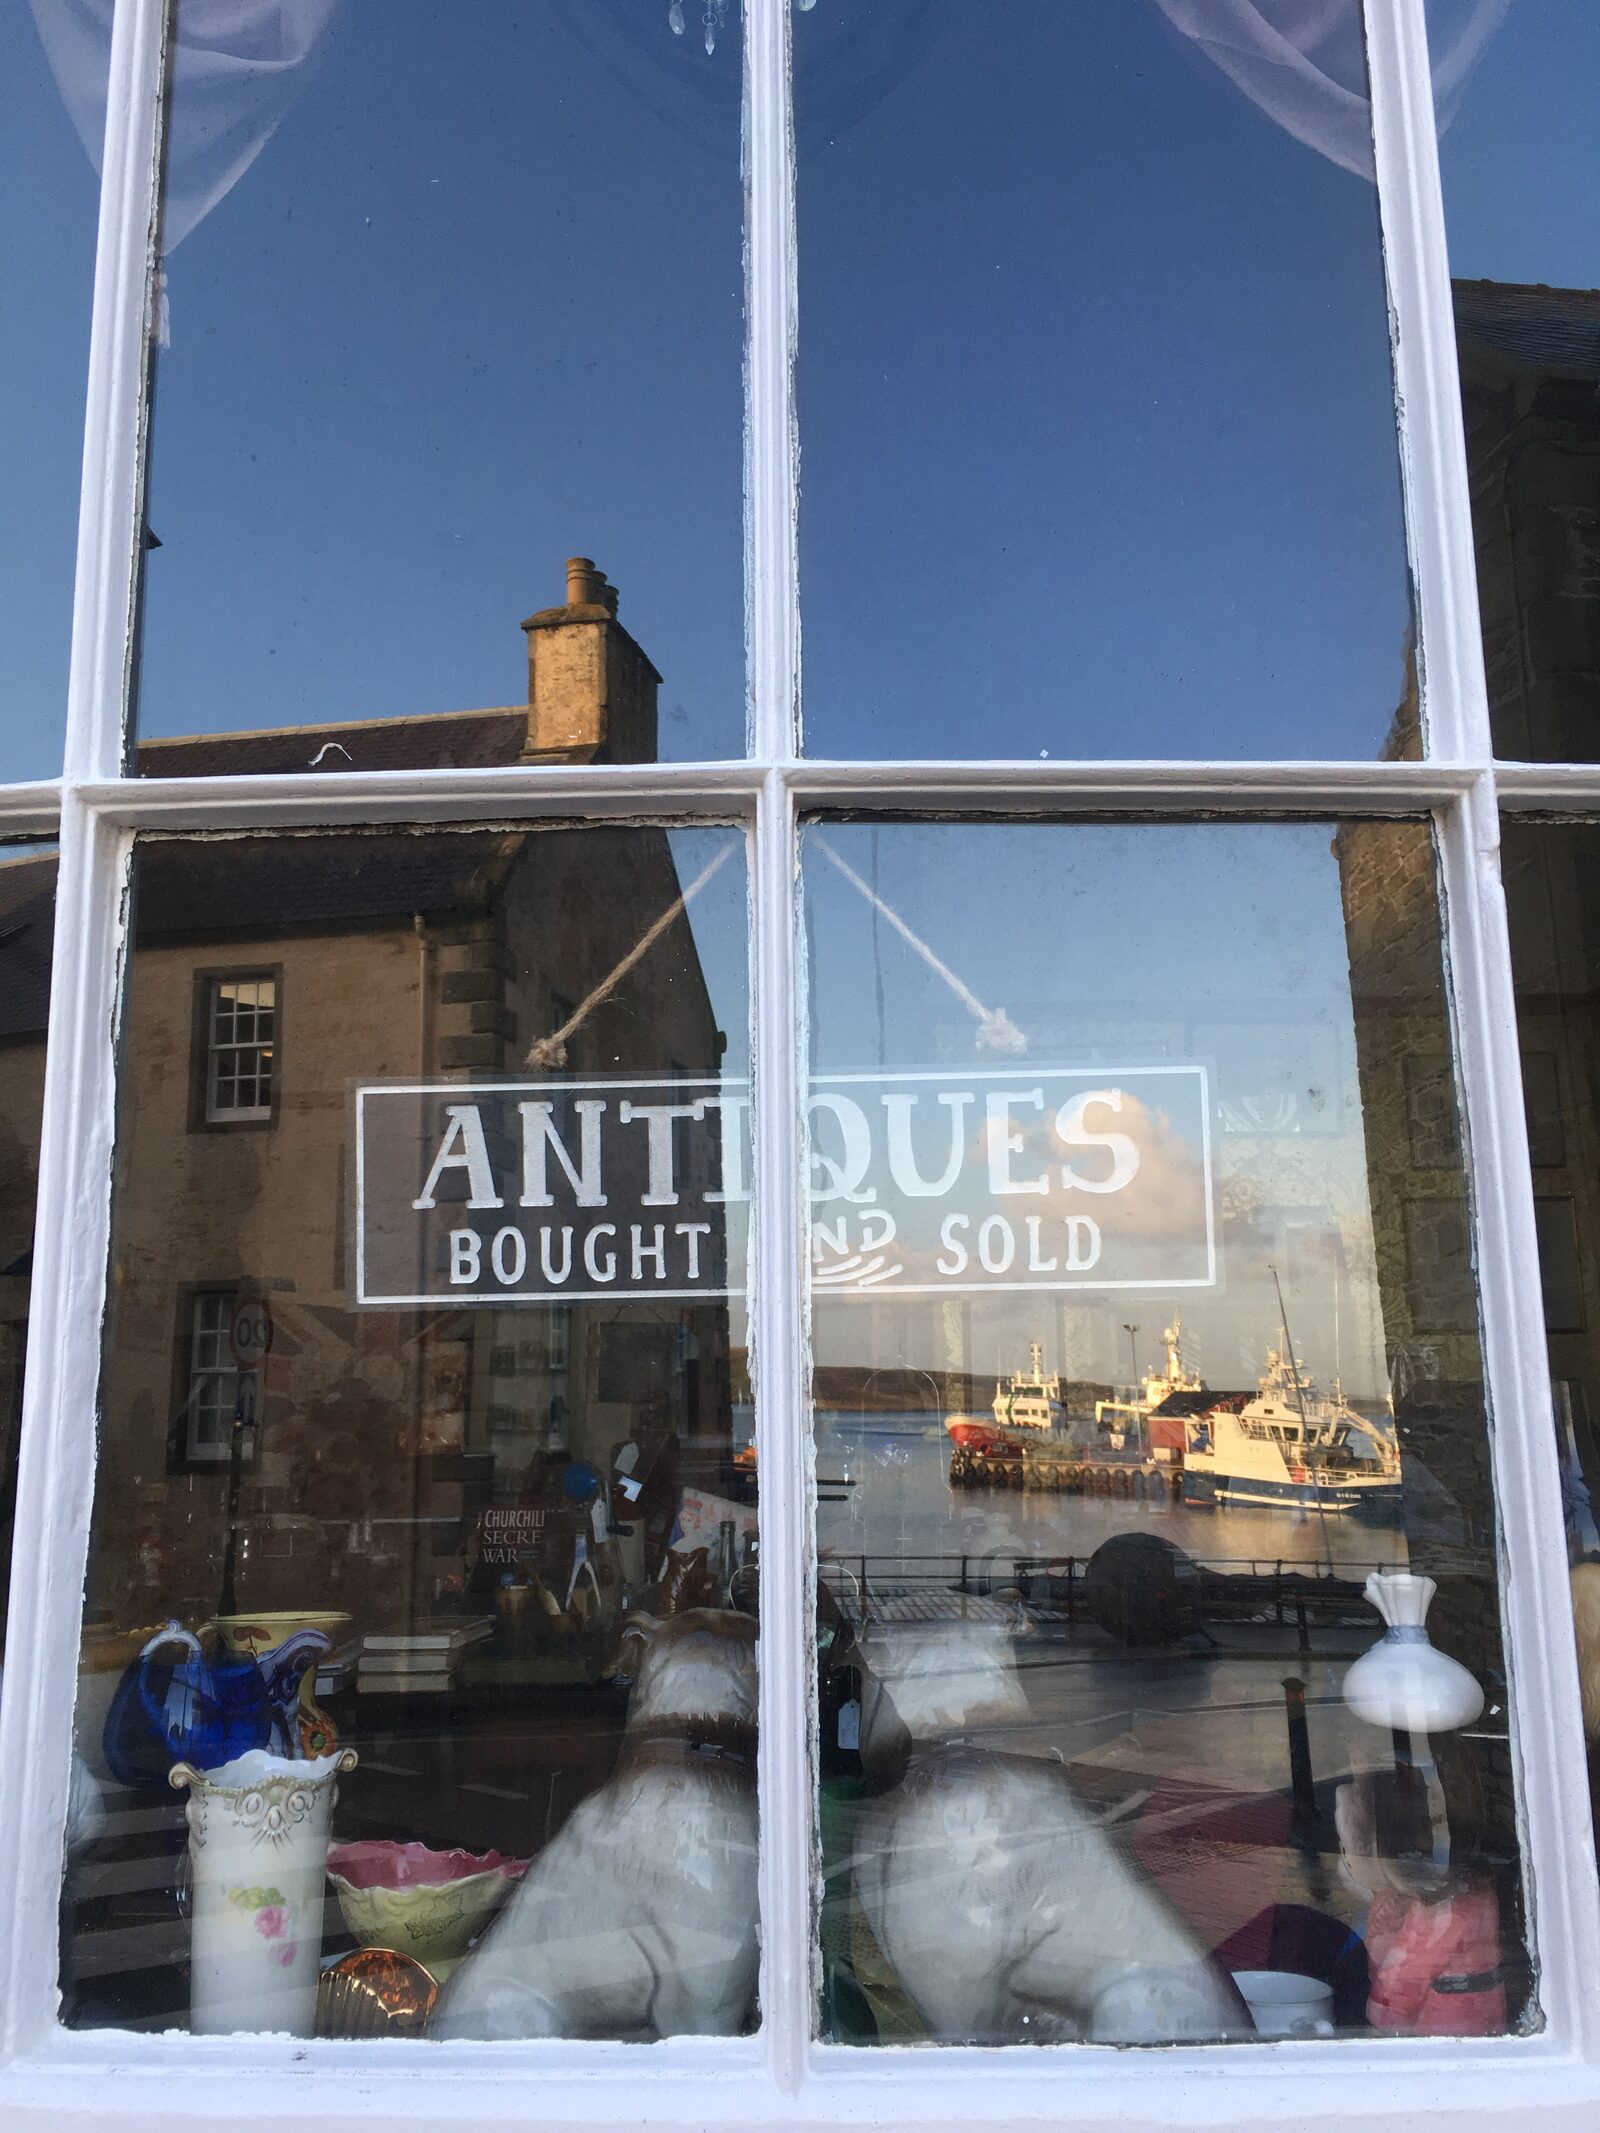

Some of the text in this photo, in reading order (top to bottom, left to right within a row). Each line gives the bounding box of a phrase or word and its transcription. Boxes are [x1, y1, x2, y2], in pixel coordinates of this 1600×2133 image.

[411, 1088, 1140, 1209] ANTIQUES
[449, 1209, 1101, 1285] BOUGHT ND SOLD
[483, 1530, 543, 1545] SECRE
[483, 1548, 520, 1563] WAR
